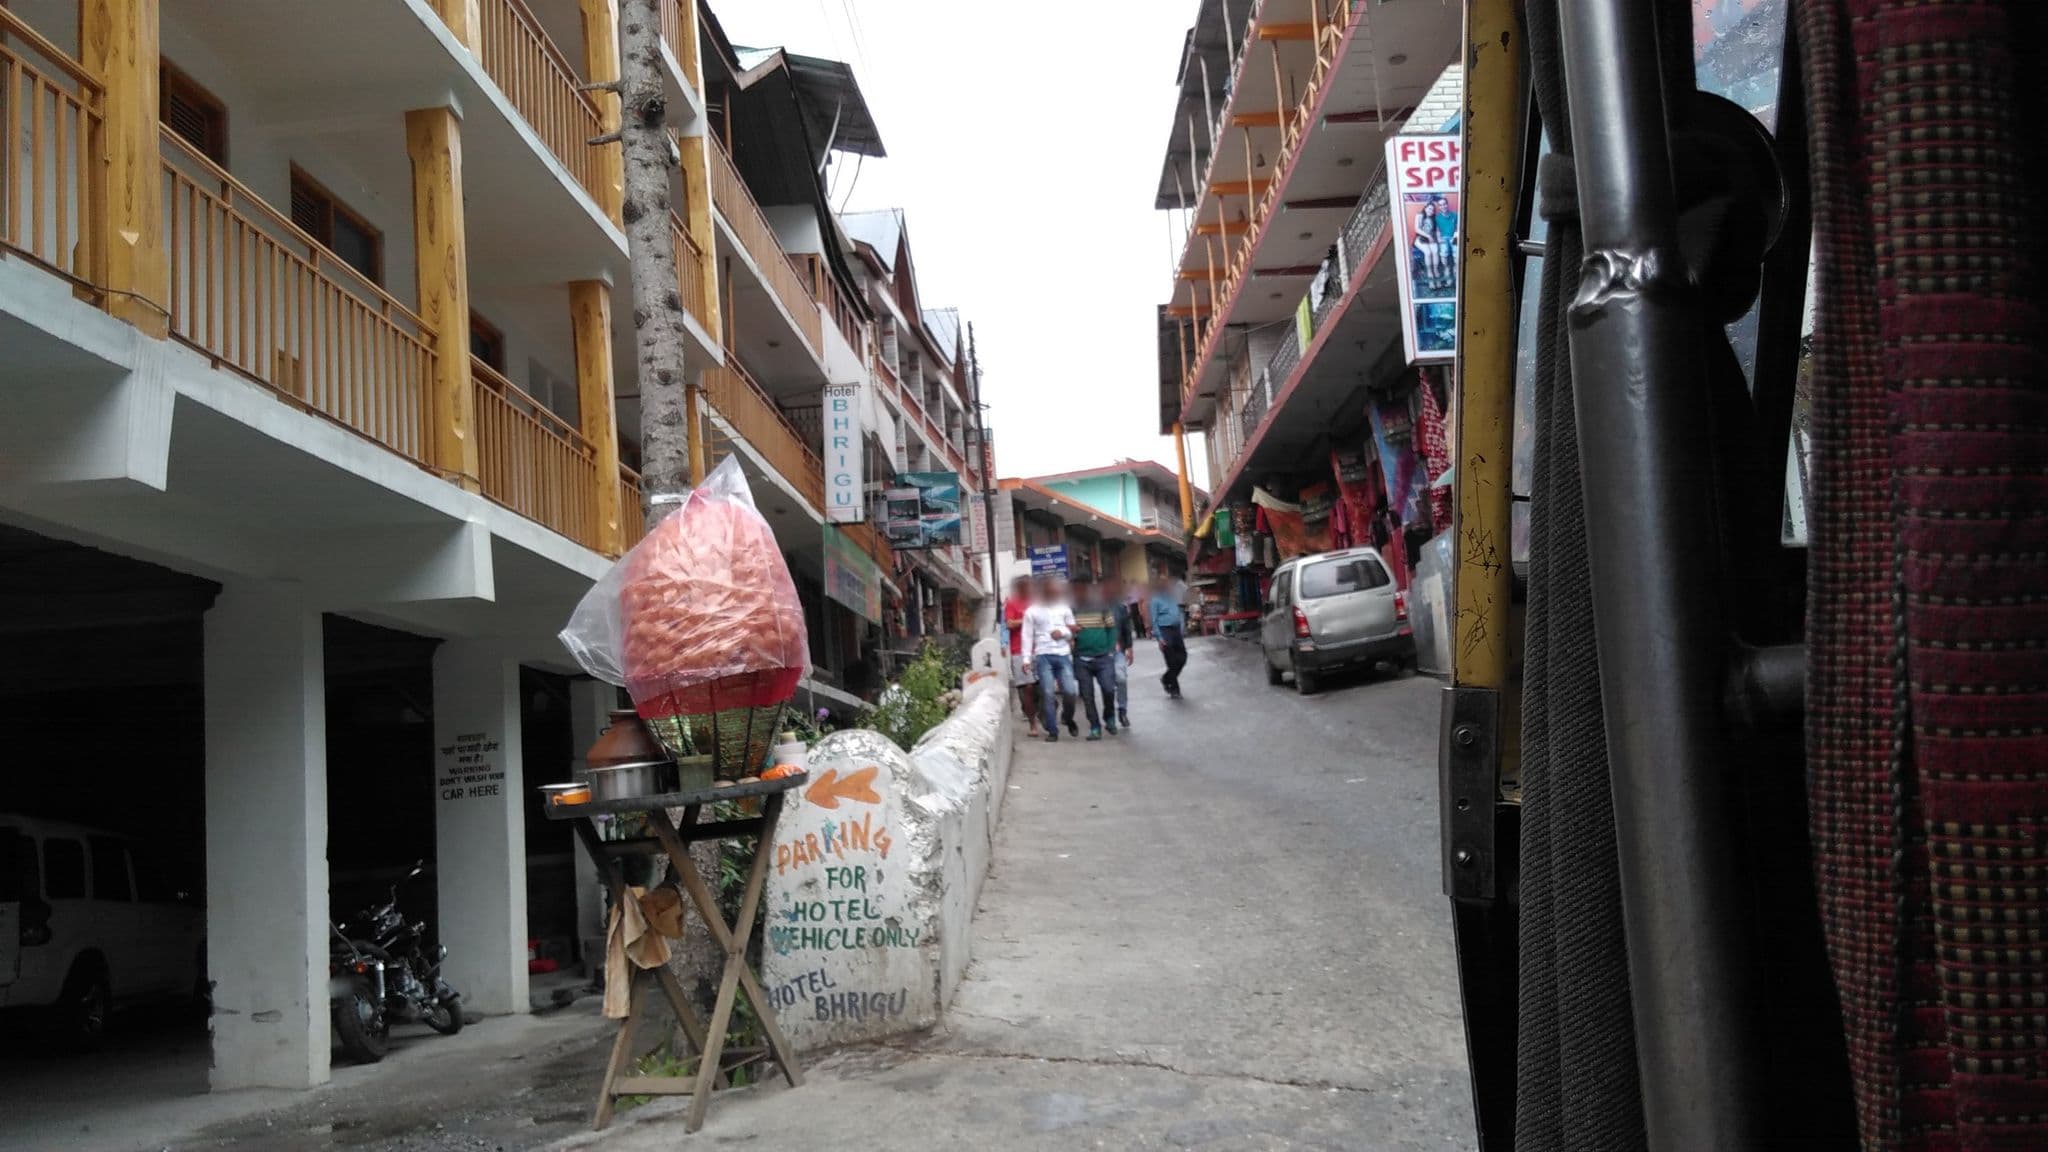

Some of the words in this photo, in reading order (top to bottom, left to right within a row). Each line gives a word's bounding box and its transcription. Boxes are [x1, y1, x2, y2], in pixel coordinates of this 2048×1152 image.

[824, 385, 857, 397] Hotel
[833, 399, 852, 506] BHRIGU
[442, 788, 464, 800] CAR
[469, 784, 499, 798] HERE
[777, 812, 892, 876] PARKING
[825, 865, 867, 894] FOR
[793, 898, 880, 922] HOTEL
[871, 926, 920, 948] ONLY
[768, 968, 836, 1009] HOTEL
[814, 987, 908, 1022] BHRIGU
